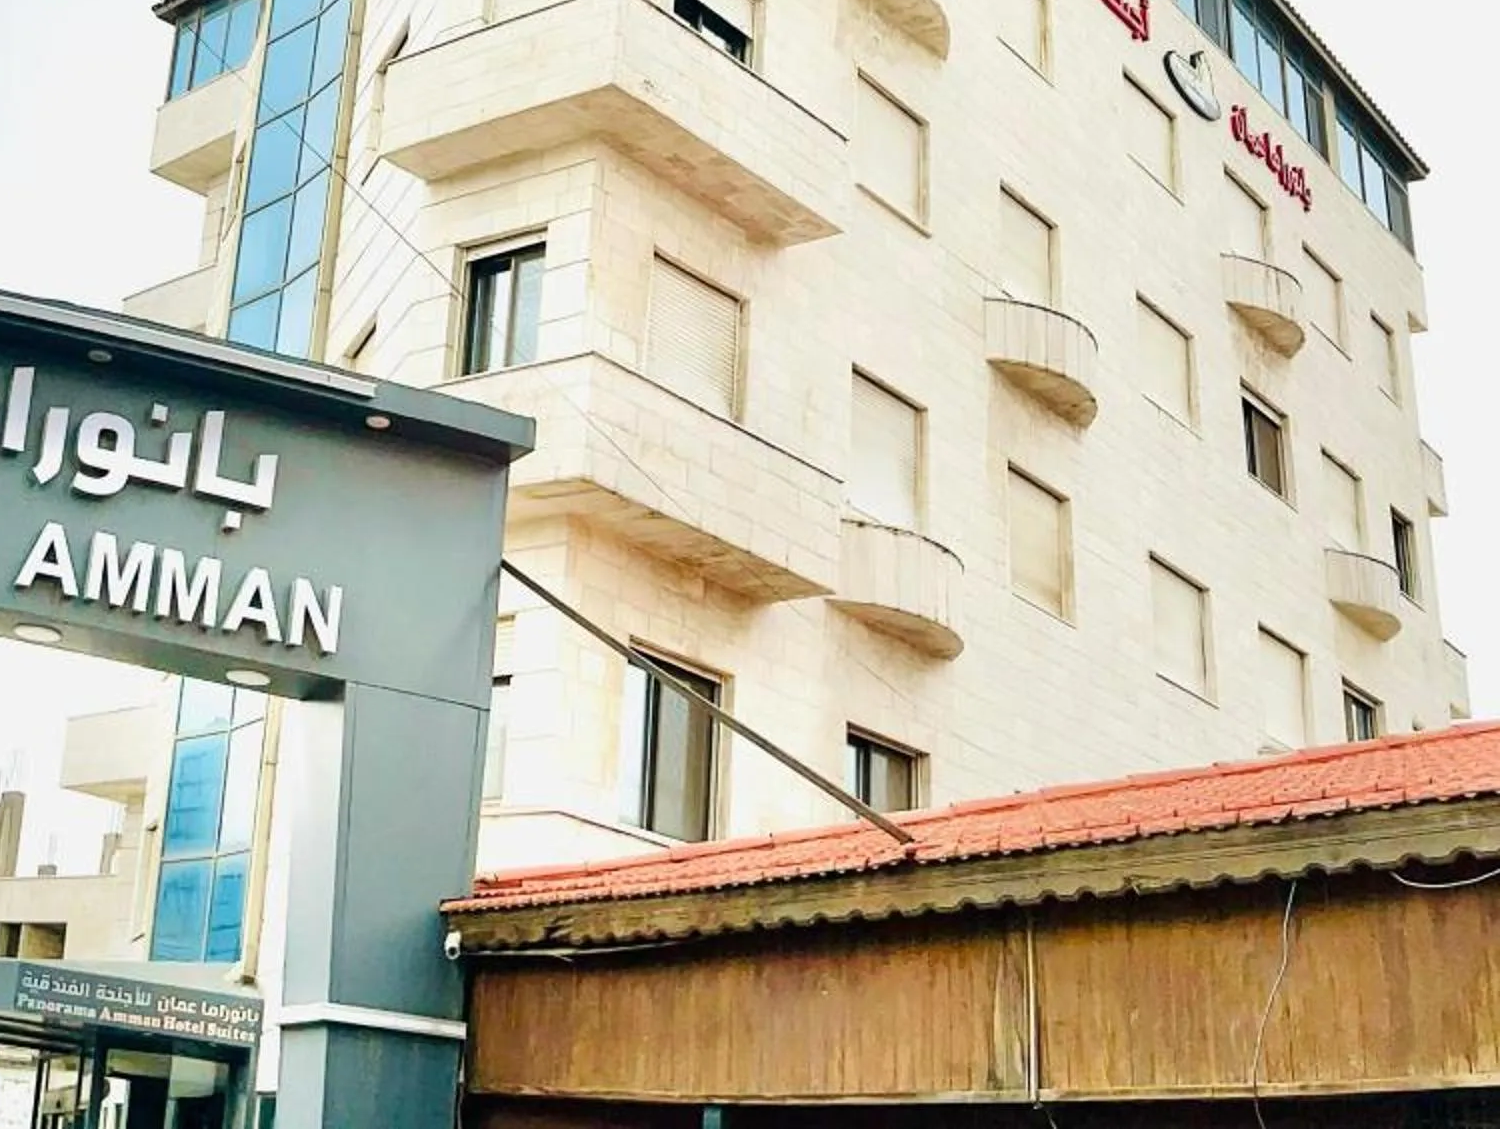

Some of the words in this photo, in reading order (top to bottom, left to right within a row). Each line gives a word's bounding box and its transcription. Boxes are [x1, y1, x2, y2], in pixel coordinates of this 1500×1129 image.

[14, 522, 344, 655] AMMAN
[21, 971, 90, 997] الفندقية
[16, 992, 97, 1018] Panorama
[99, 1006, 161, 1028] Amman
[162, 1014, 205, 1034] Hotel
[207, 1022, 257, 1042] Suites
[157, 995, 197, 1013] عمان
[201, 1000, 260, 1026] بانوراما
